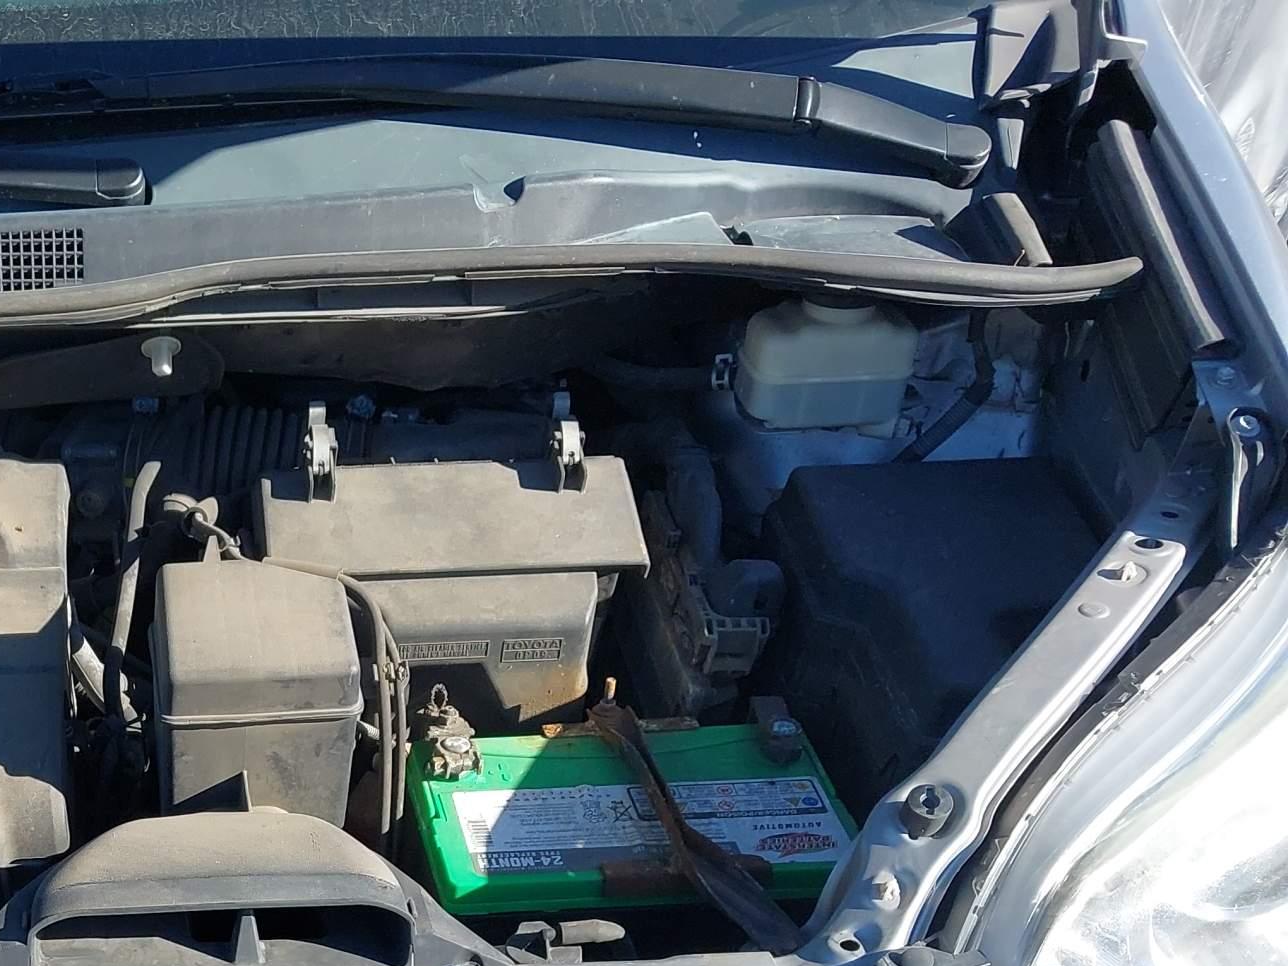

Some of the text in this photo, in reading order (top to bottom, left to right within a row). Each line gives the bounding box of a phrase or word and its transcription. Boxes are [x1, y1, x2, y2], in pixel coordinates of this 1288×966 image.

[504, 639, 561, 651] TOYOTA
[752, 821, 823, 831] AUTOMOTIVE
[477, 855, 564, 869] 24-MONTH
